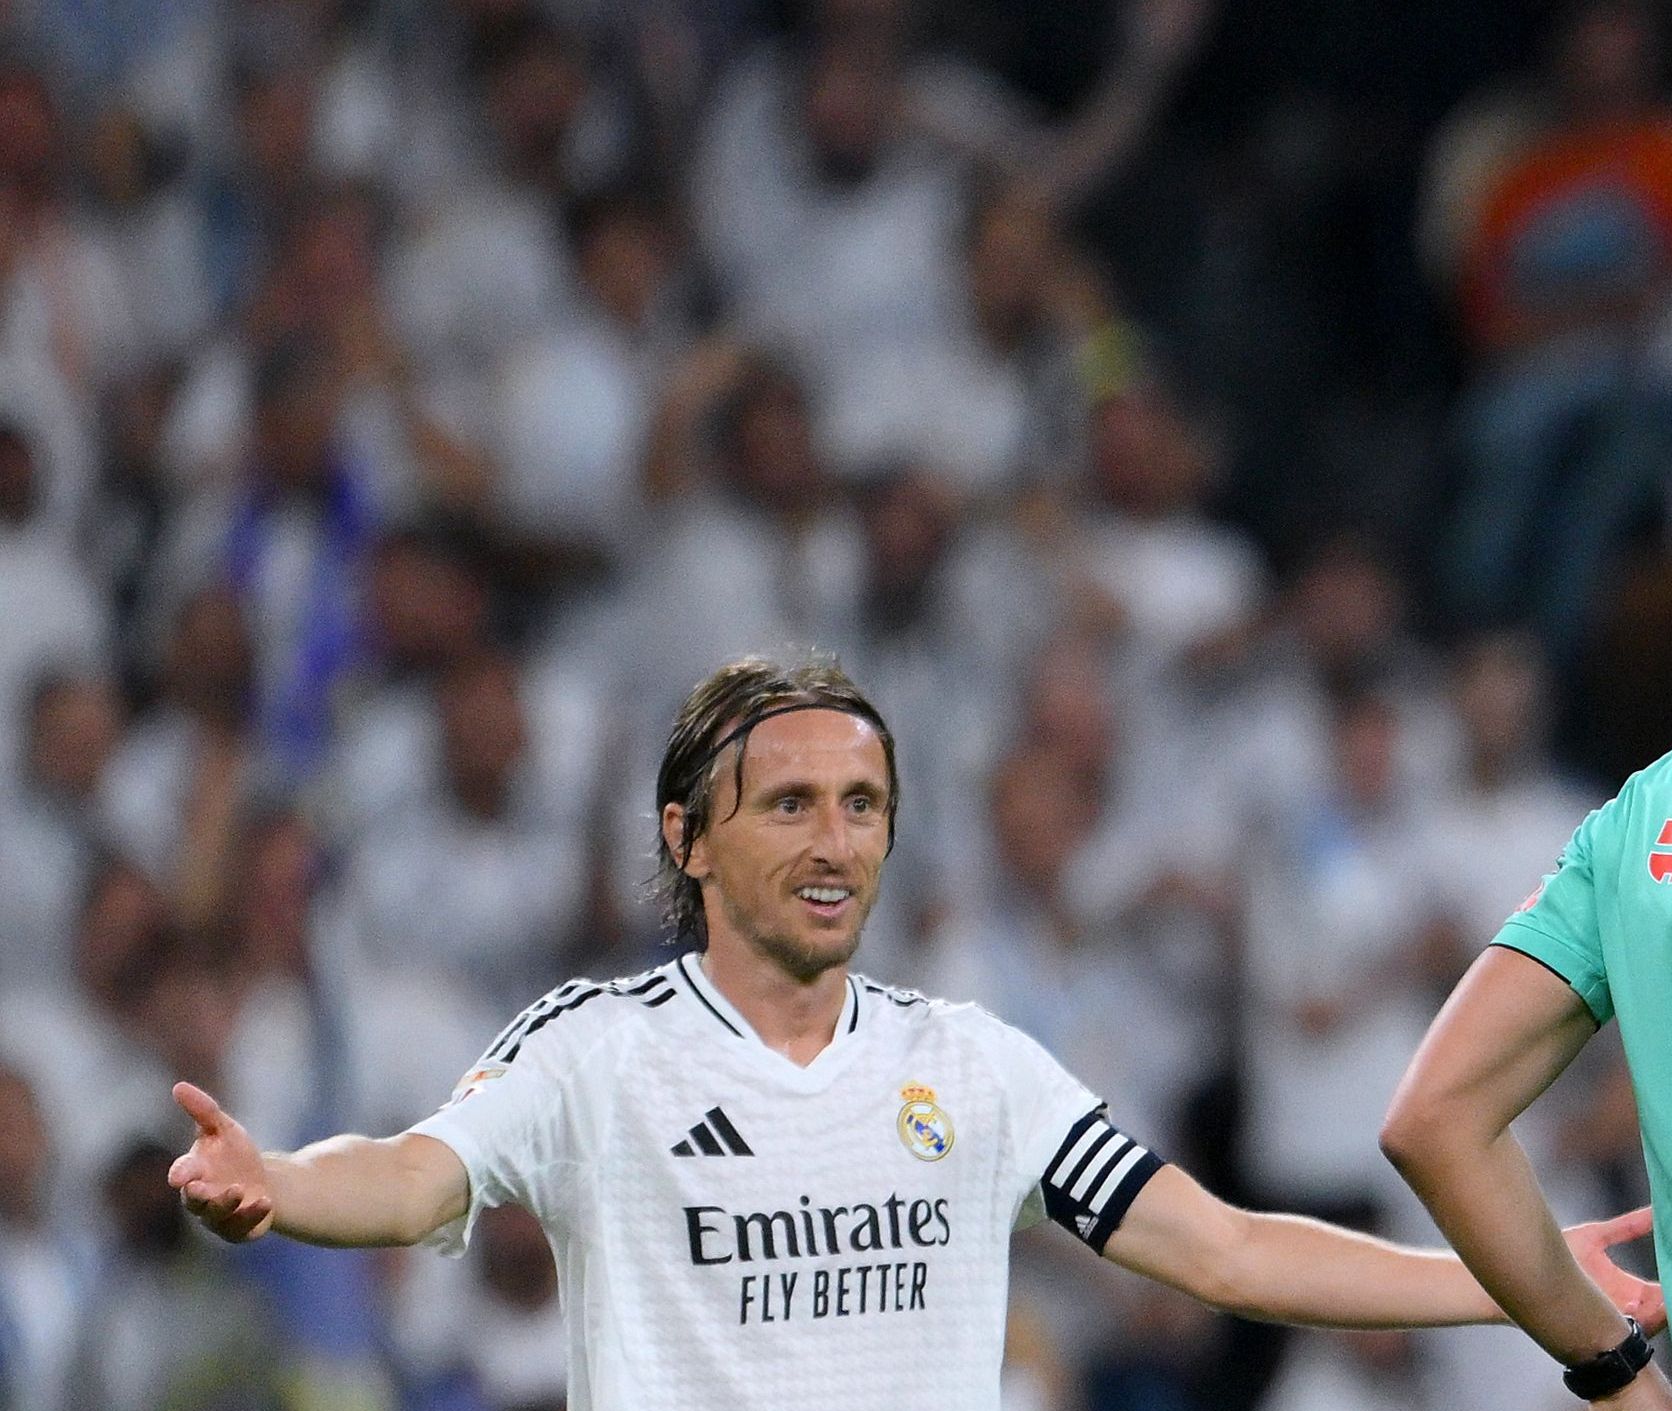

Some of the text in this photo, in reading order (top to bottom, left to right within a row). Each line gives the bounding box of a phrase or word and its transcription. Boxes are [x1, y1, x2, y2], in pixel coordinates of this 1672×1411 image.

[683, 1192, 951, 1266] Emirates
[739, 1261, 928, 1325] FLY BETTER
